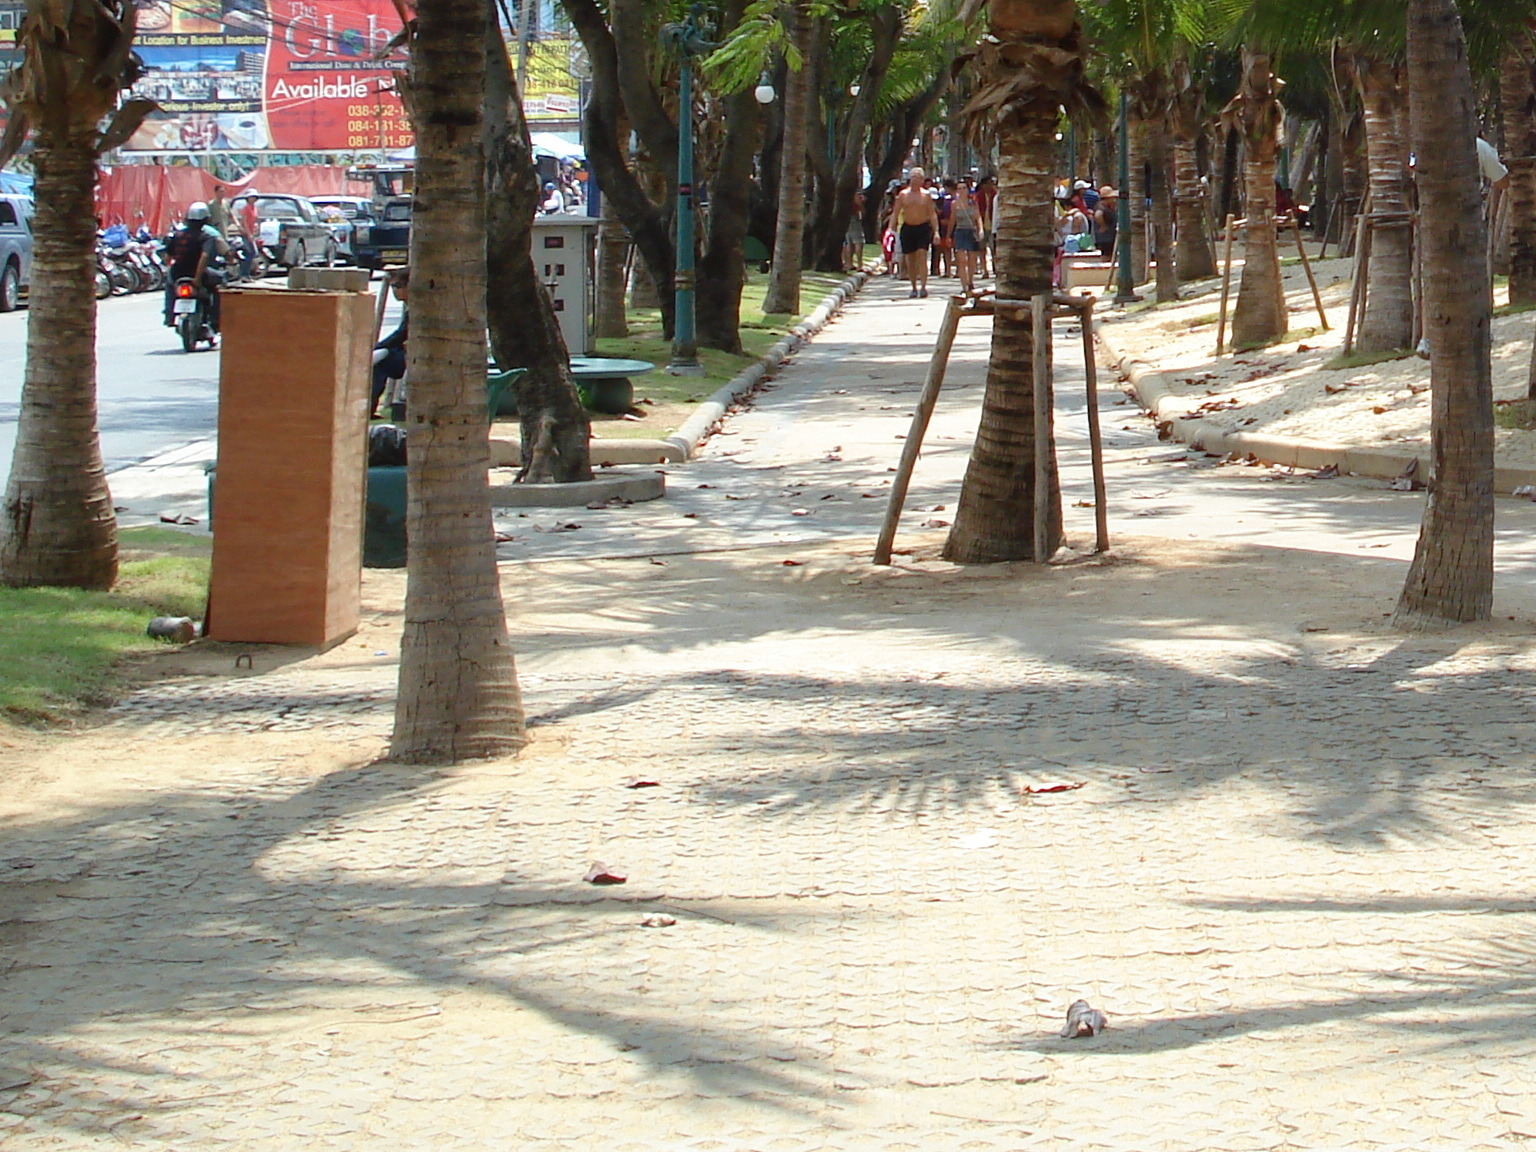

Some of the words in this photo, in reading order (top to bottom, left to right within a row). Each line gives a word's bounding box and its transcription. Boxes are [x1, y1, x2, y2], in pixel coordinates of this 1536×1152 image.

[287, 1, 318, 16] The
[143, 35, 176, 45] Location
[177, 35, 189, 45] for
[190, 35, 224, 45] Business
[285, 14, 410, 59] Glob
[384, 60, 407, 71] Comp
[271, 75, 368, 99] Available
[158, 102, 189, 112] Serious
[192, 102, 225, 112] Investor
